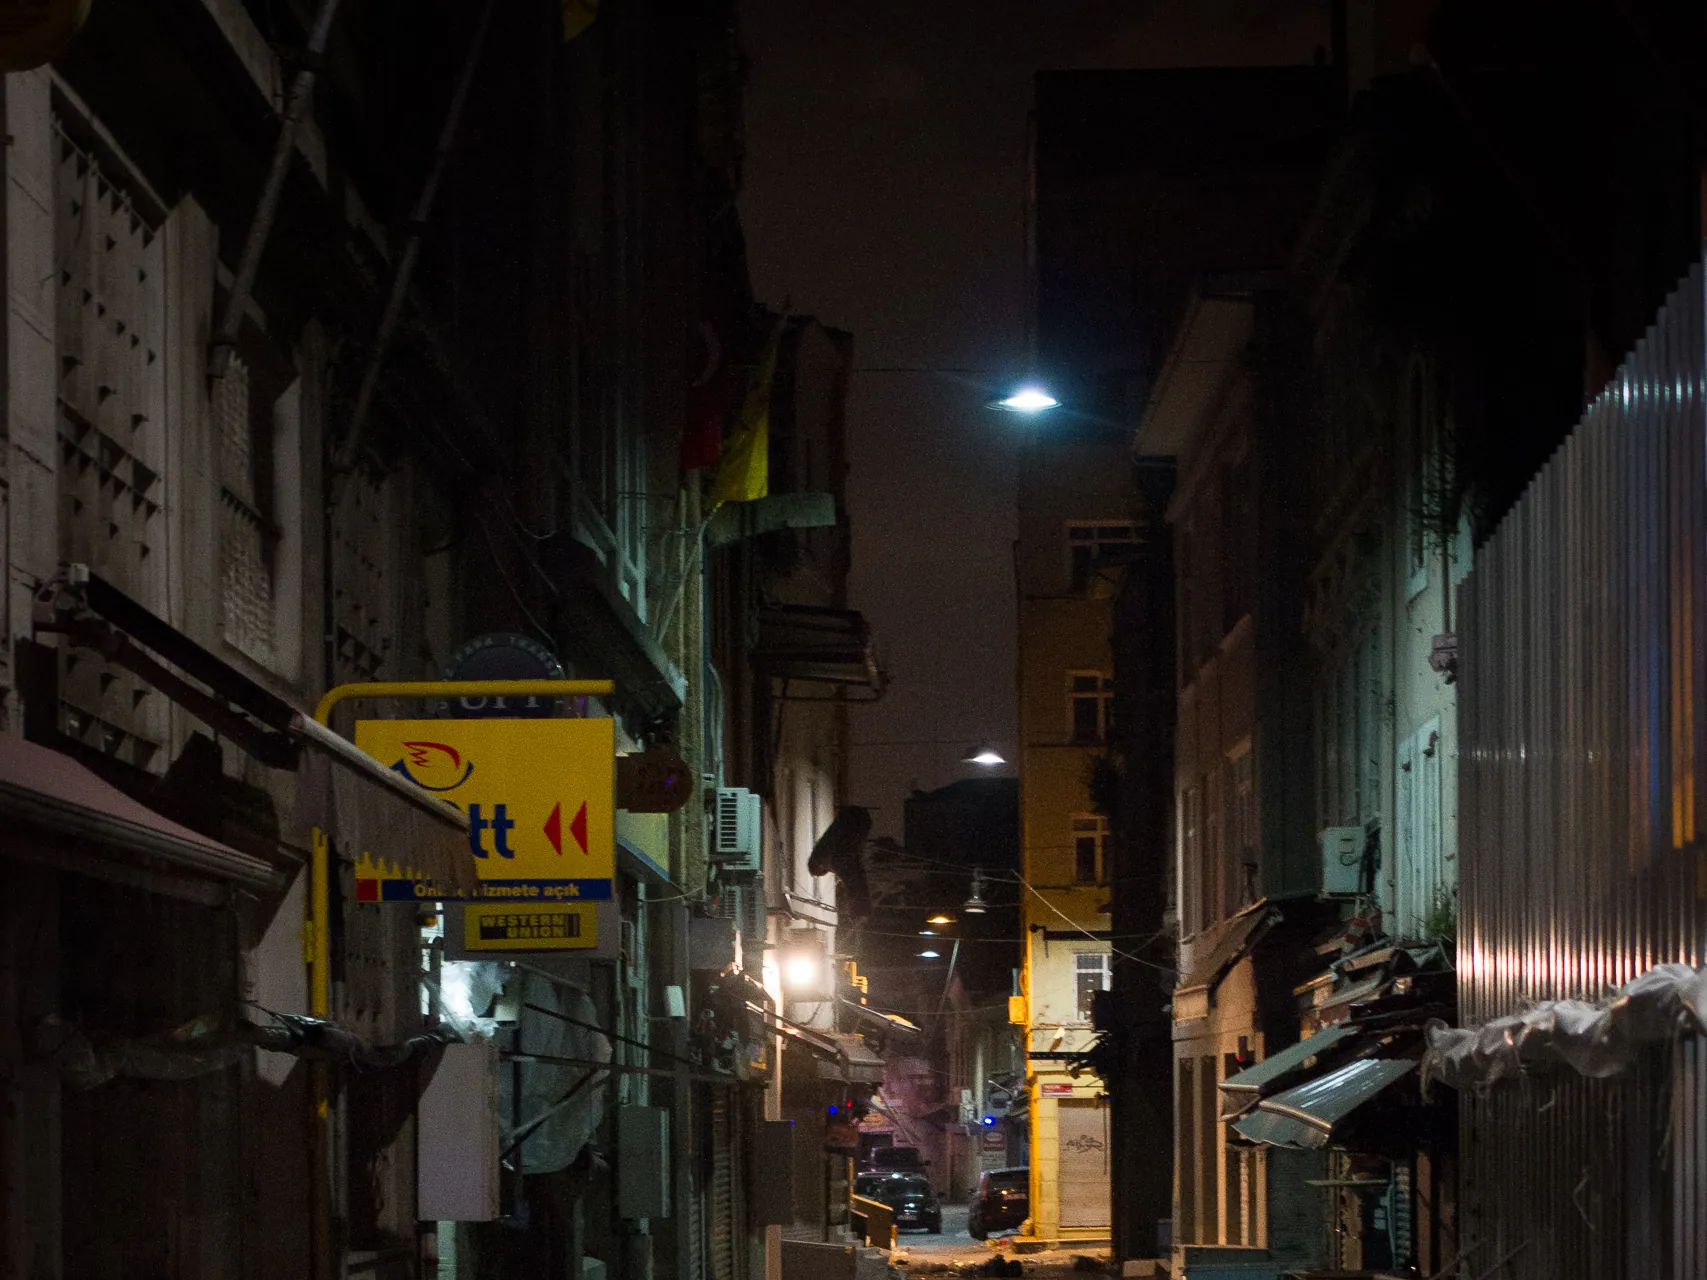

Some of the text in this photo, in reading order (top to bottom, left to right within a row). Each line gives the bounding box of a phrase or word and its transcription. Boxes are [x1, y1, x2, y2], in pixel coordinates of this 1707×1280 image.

[443, 800, 516, 859] tt
[481, 914, 566, 927] WESTERN
[507, 926, 566, 938] UNION
